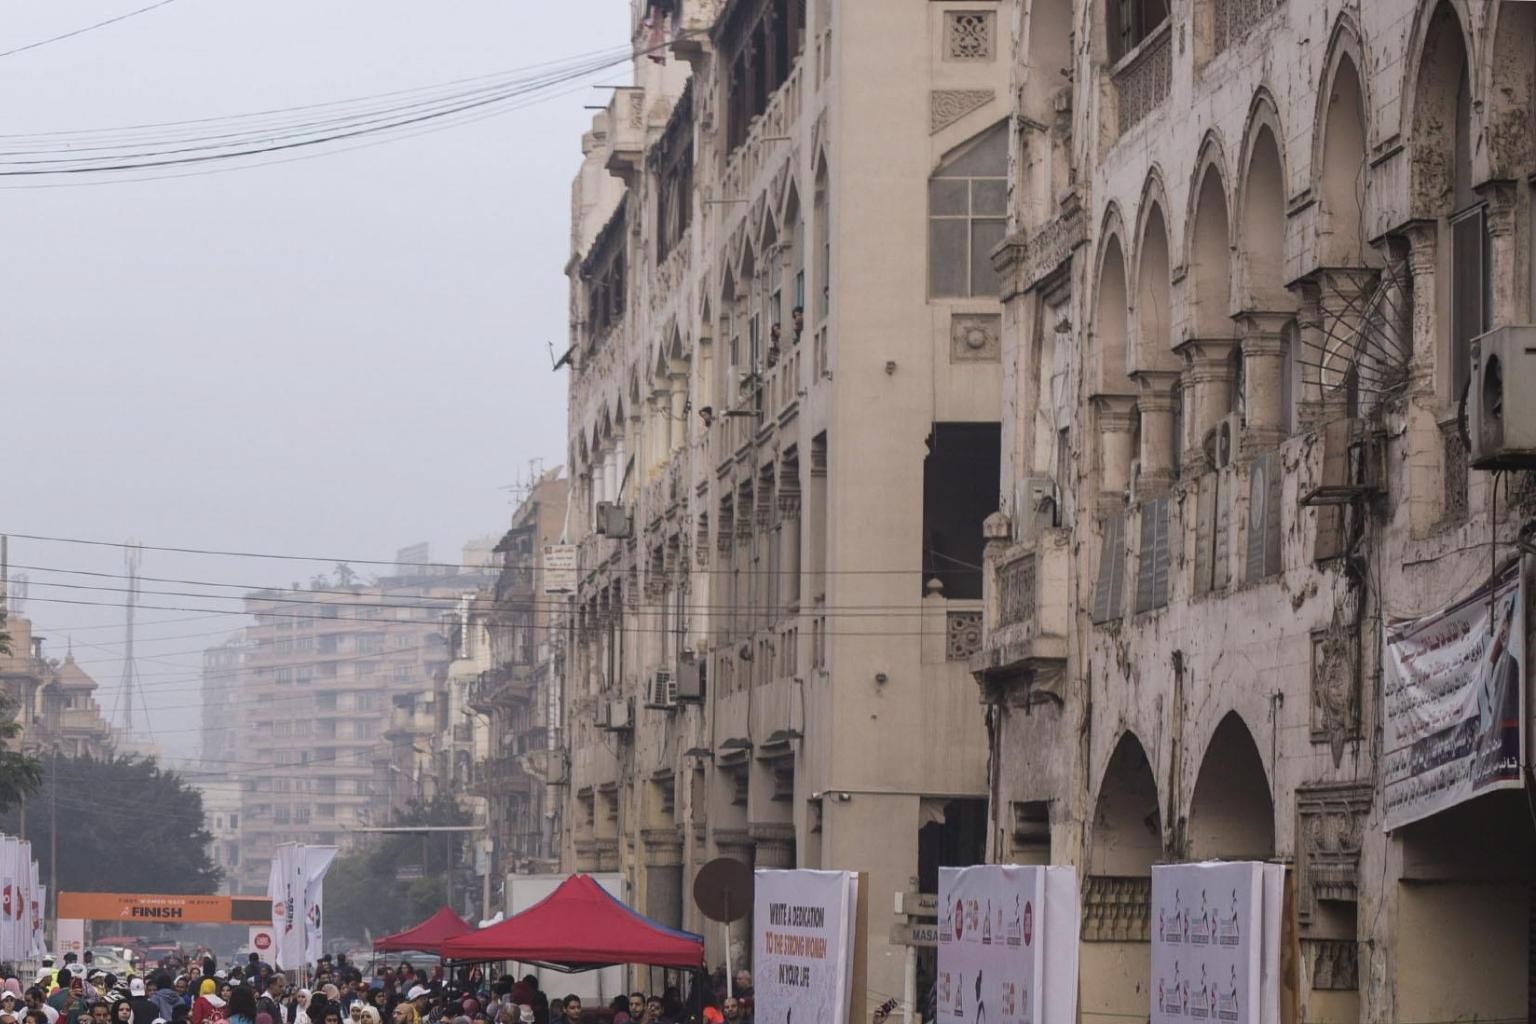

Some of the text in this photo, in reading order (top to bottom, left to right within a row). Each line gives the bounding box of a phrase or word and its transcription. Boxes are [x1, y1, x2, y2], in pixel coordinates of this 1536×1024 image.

[131, 906, 183, 918] FINISH
[769, 903, 825, 928] WRITE A DEDICATION
[766, 931, 827, 960] TO THE STRONG WOMEN
[779, 964, 809, 988] IN YOUR LIFE
